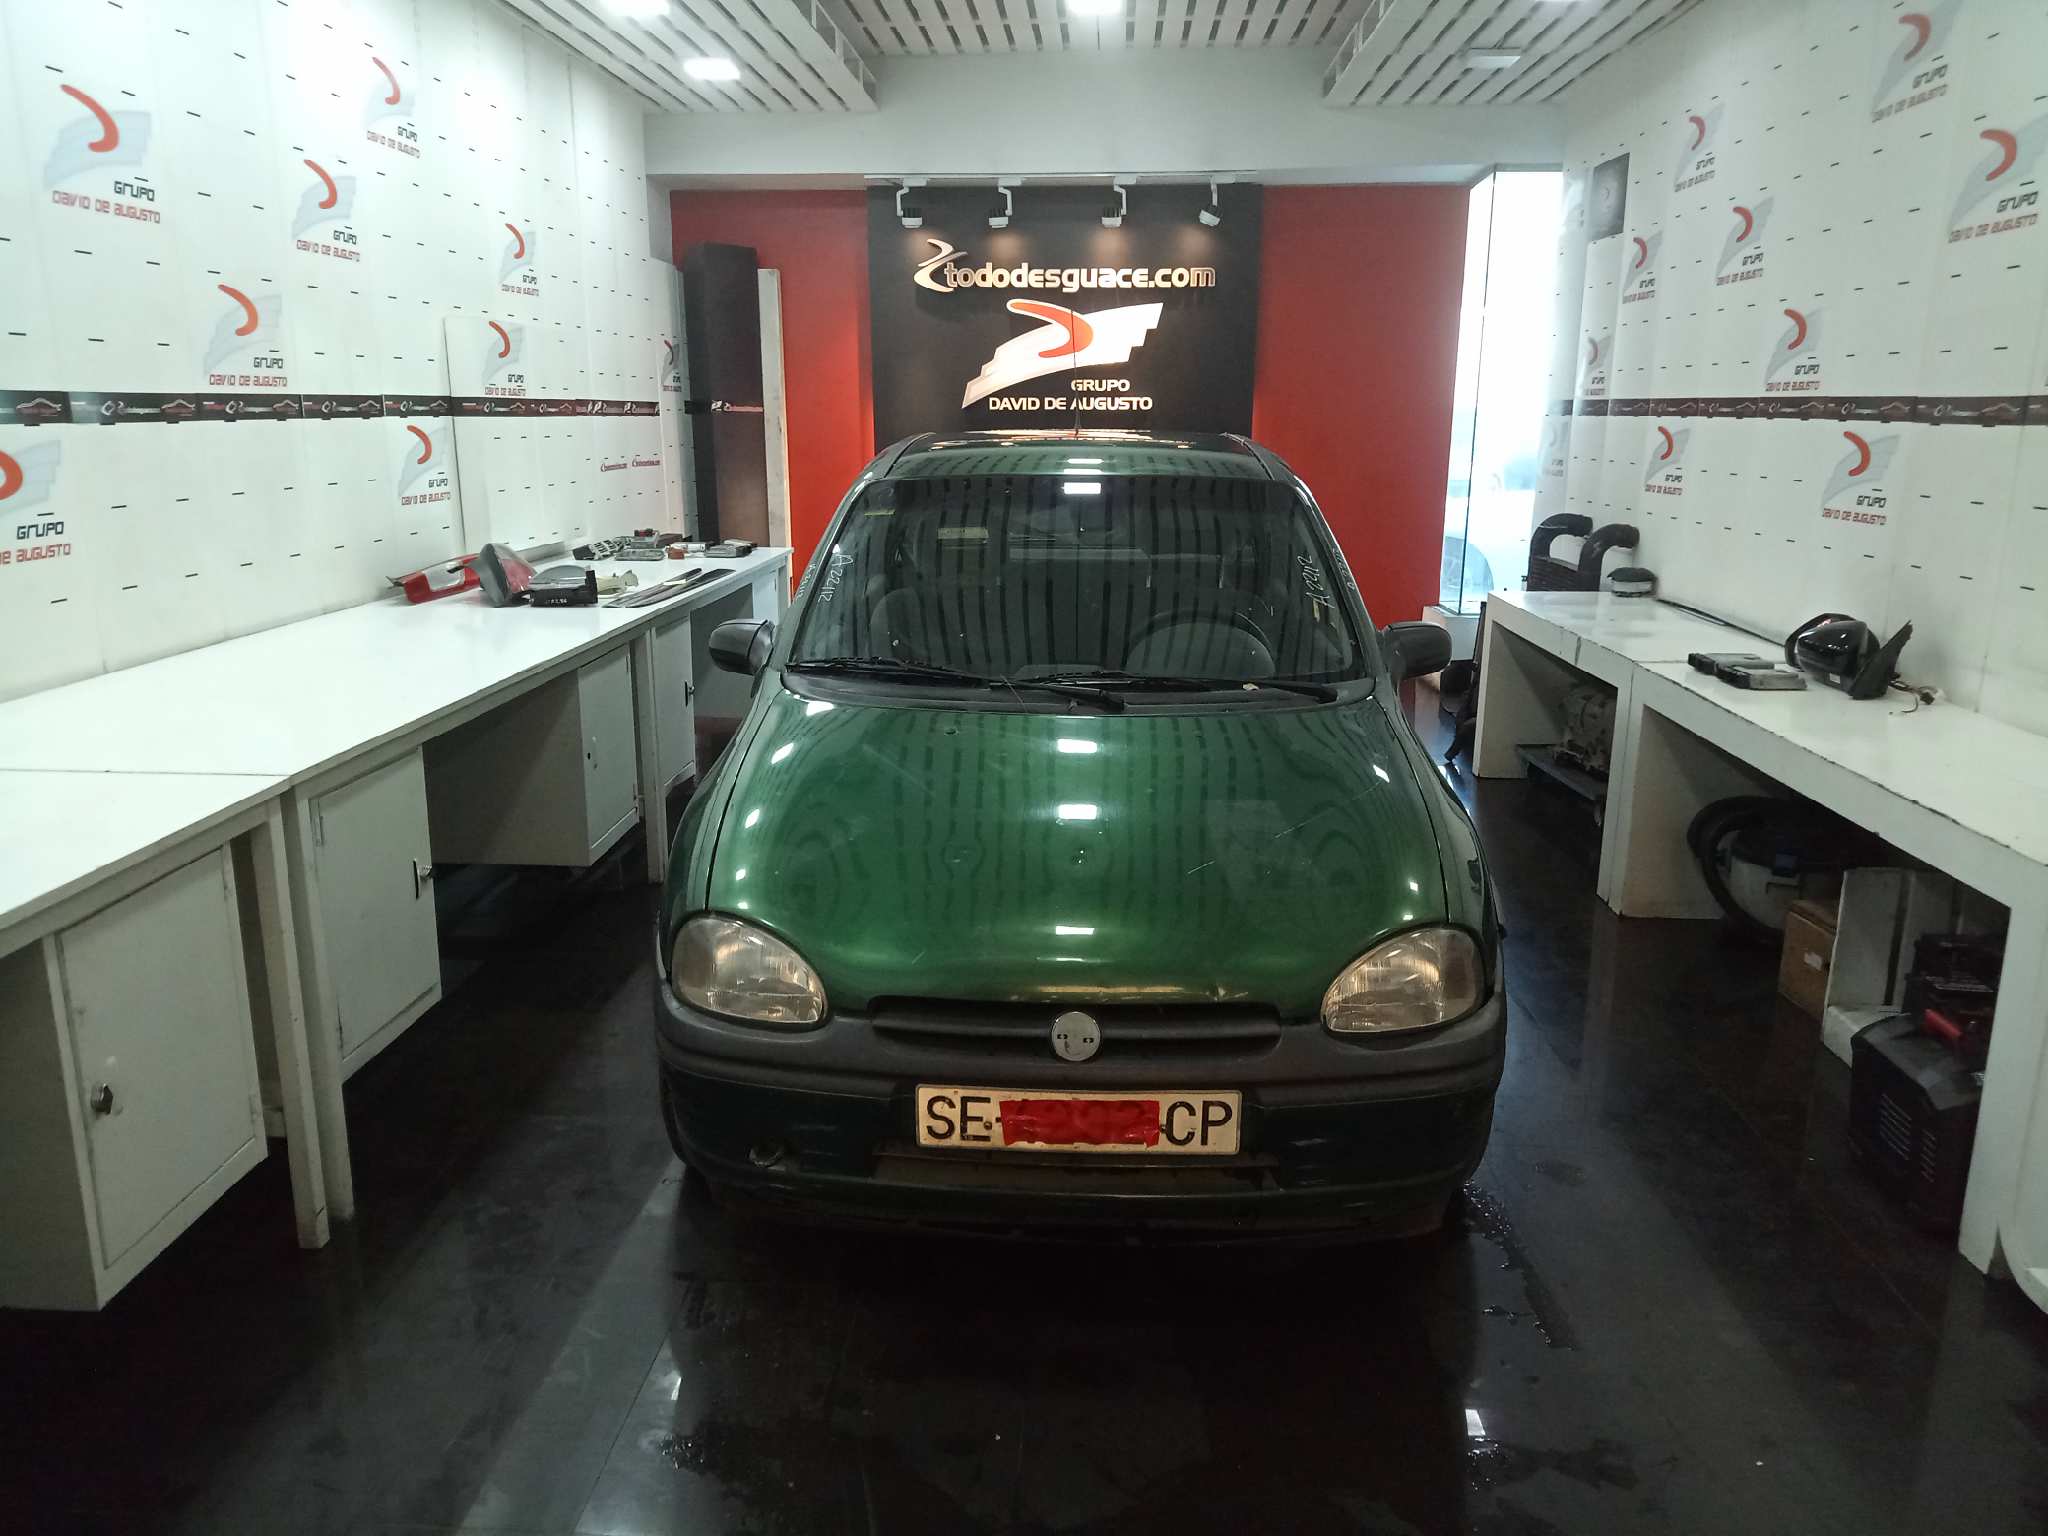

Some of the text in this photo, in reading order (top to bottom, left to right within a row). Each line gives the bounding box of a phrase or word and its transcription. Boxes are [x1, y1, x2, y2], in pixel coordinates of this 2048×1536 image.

[114, 180, 155, 202] GRUPO
[1996, 191, 2039, 213] GRUPO
[944, 262, 1216, 293] tododesguace.com
[253, 357, 284, 369] GRUPO
[1070, 379, 1131, 392] GRUPO
[988, 396, 1153, 411] DAVID DE AUGUSTO
[16, 521, 64, 540] GRUPO
[16, 543, 71, 563] AUGUSTO
[1165, 1100, 1233, 1147] CP
